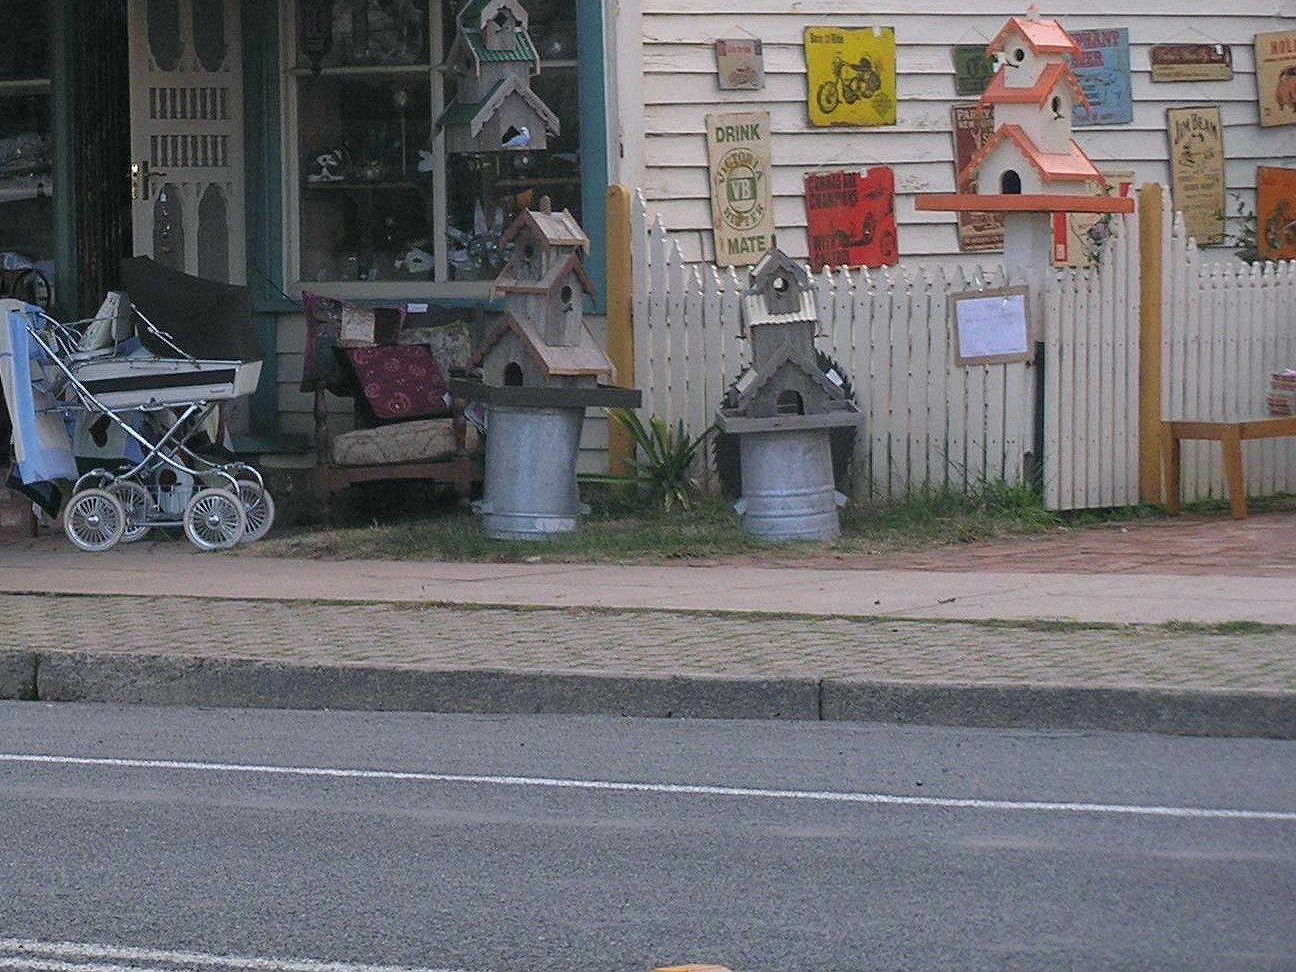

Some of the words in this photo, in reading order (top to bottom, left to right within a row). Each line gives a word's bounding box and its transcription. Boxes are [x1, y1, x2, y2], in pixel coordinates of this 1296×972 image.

[714, 123, 761, 143] DRINK
[730, 179, 752, 202] VB
[727, 235, 767, 255] MATE
